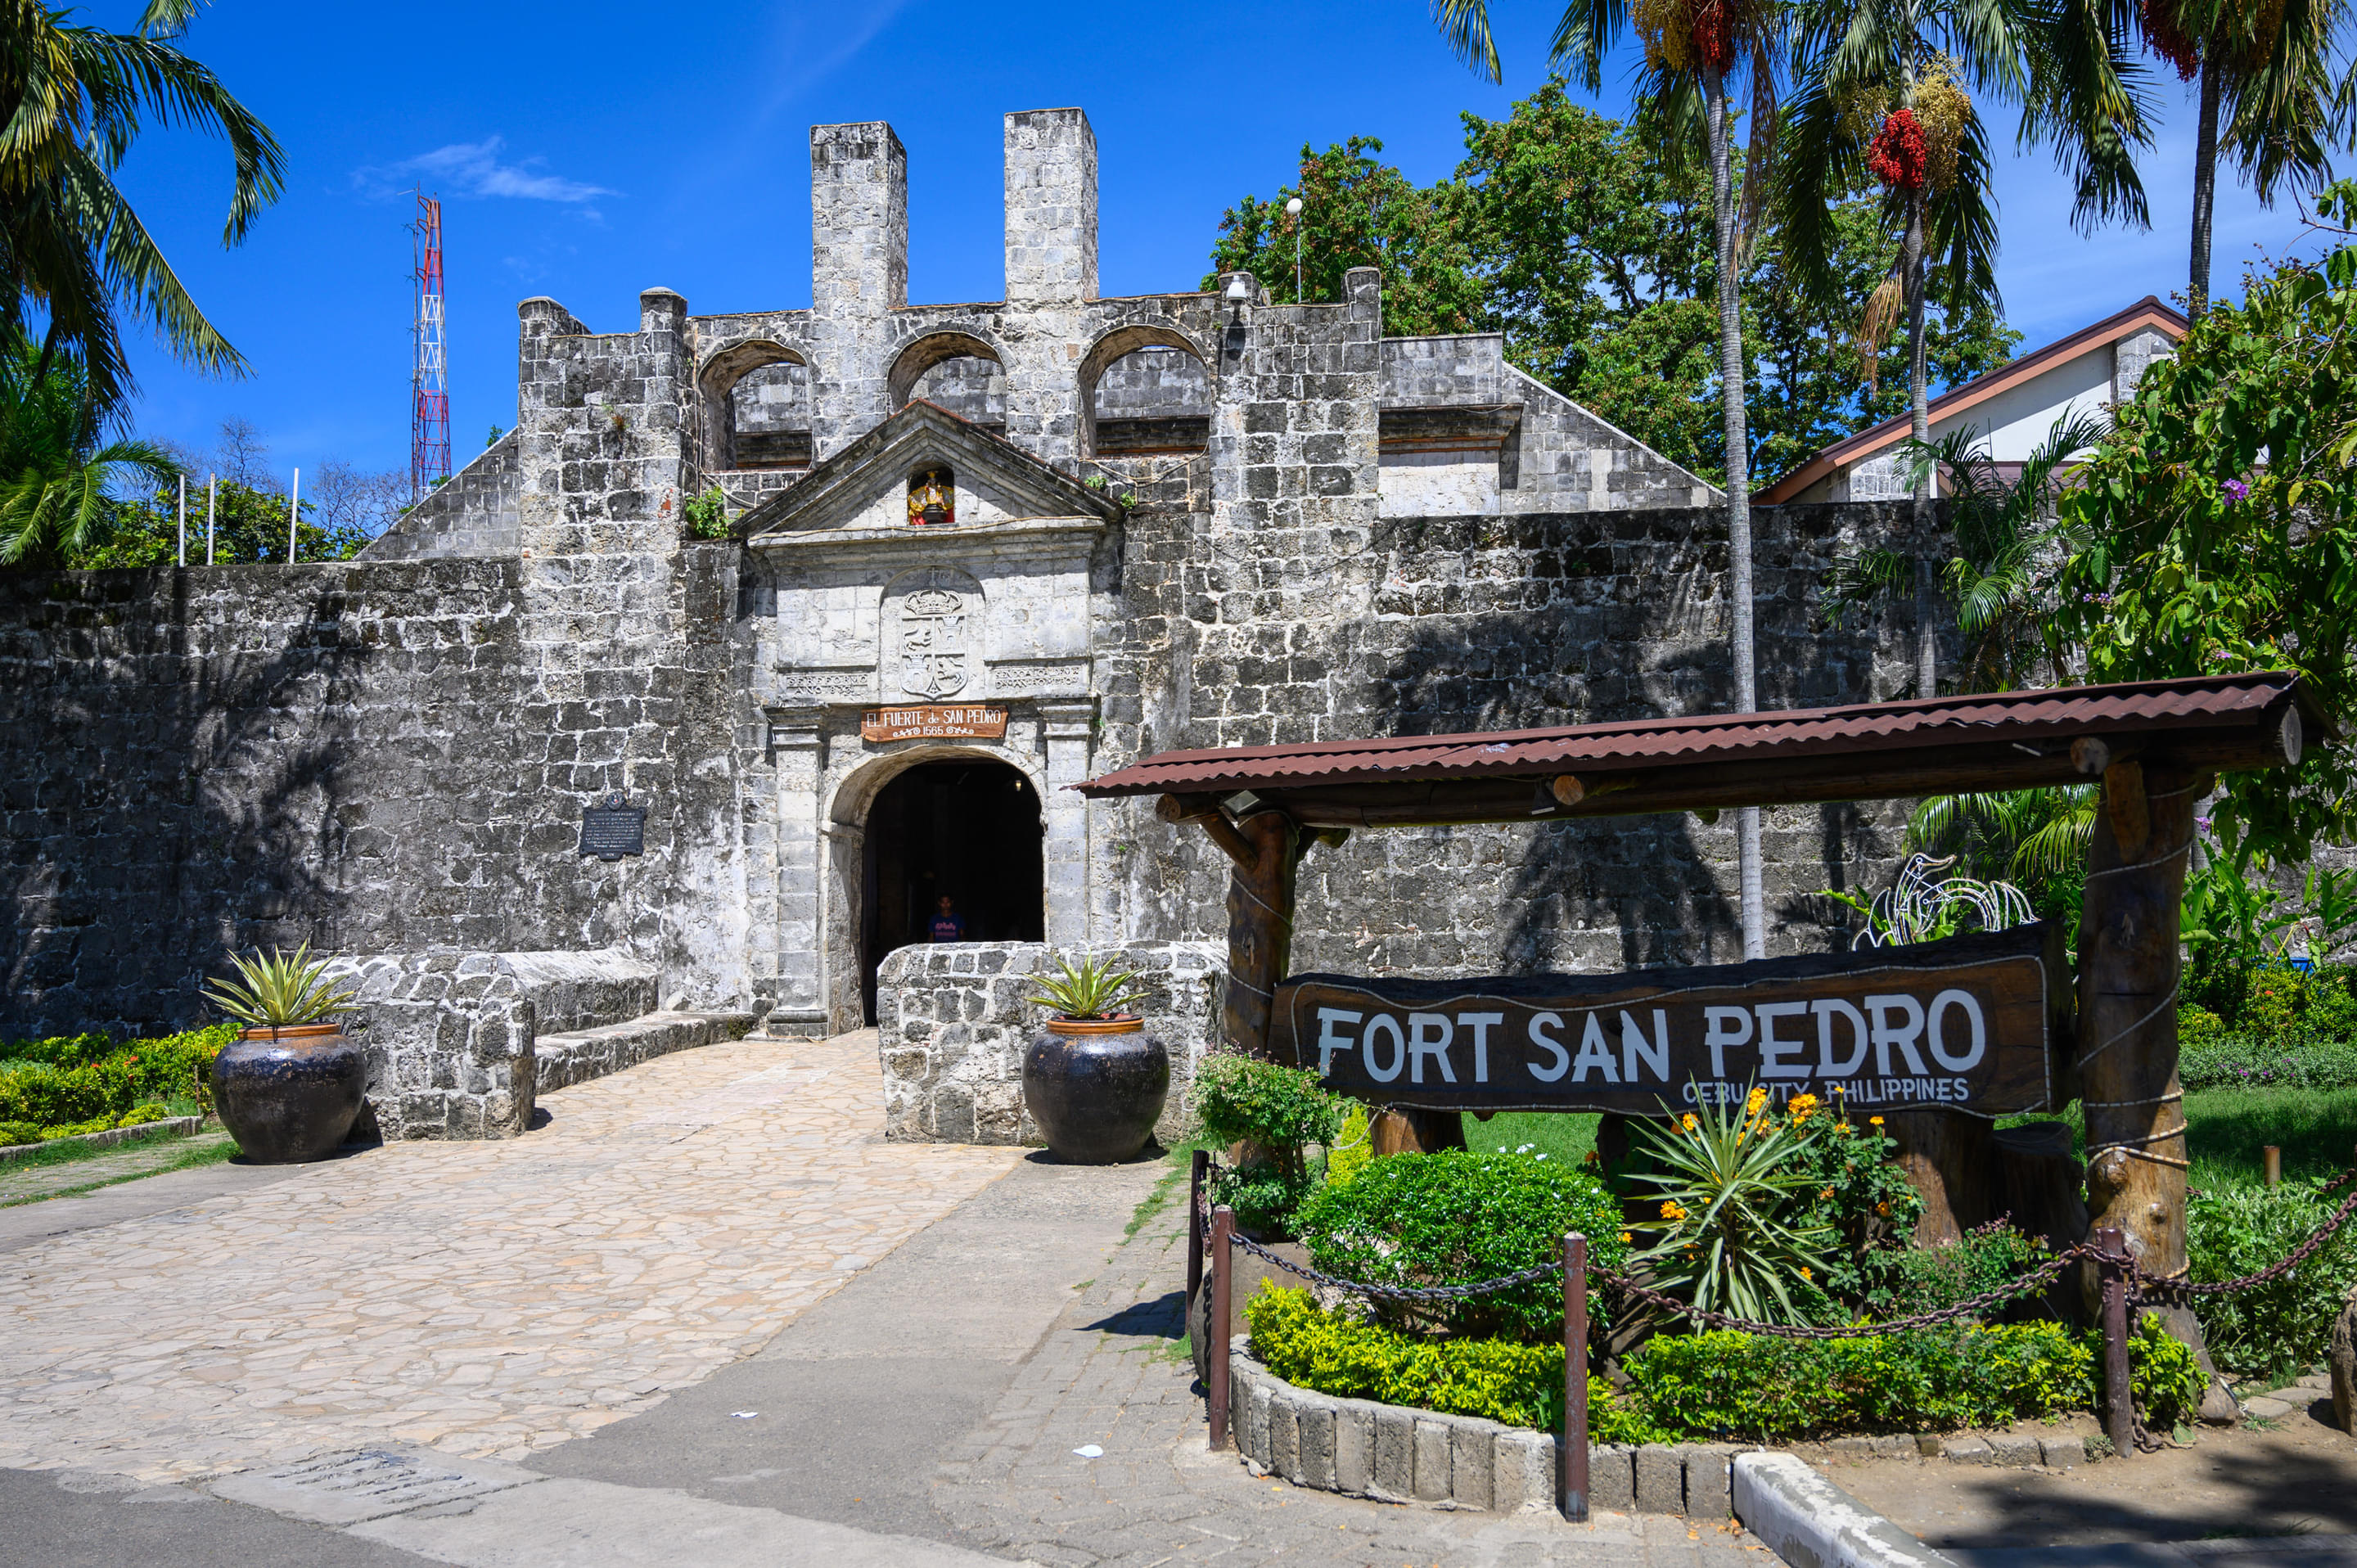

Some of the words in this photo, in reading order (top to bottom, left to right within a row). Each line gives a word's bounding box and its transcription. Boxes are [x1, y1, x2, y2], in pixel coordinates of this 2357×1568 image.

[867, 713, 881, 728] EL
[884, 710, 924, 727] FUERTE
[928, 711, 940, 723] de
[943, 710, 963, 724] SAN
[967, 709, 1001, 724] PEDRO
[923, 726, 944, 736] 1565
[1317, 1007, 1504, 1084] FORT
[1526, 1008, 1670, 1083] SAN
[1704, 989, 1986, 1078] PEDRO
[1682, 1081, 1744, 1104] CEBU
[1824, 1077, 1969, 1103] PHILIPPINES
